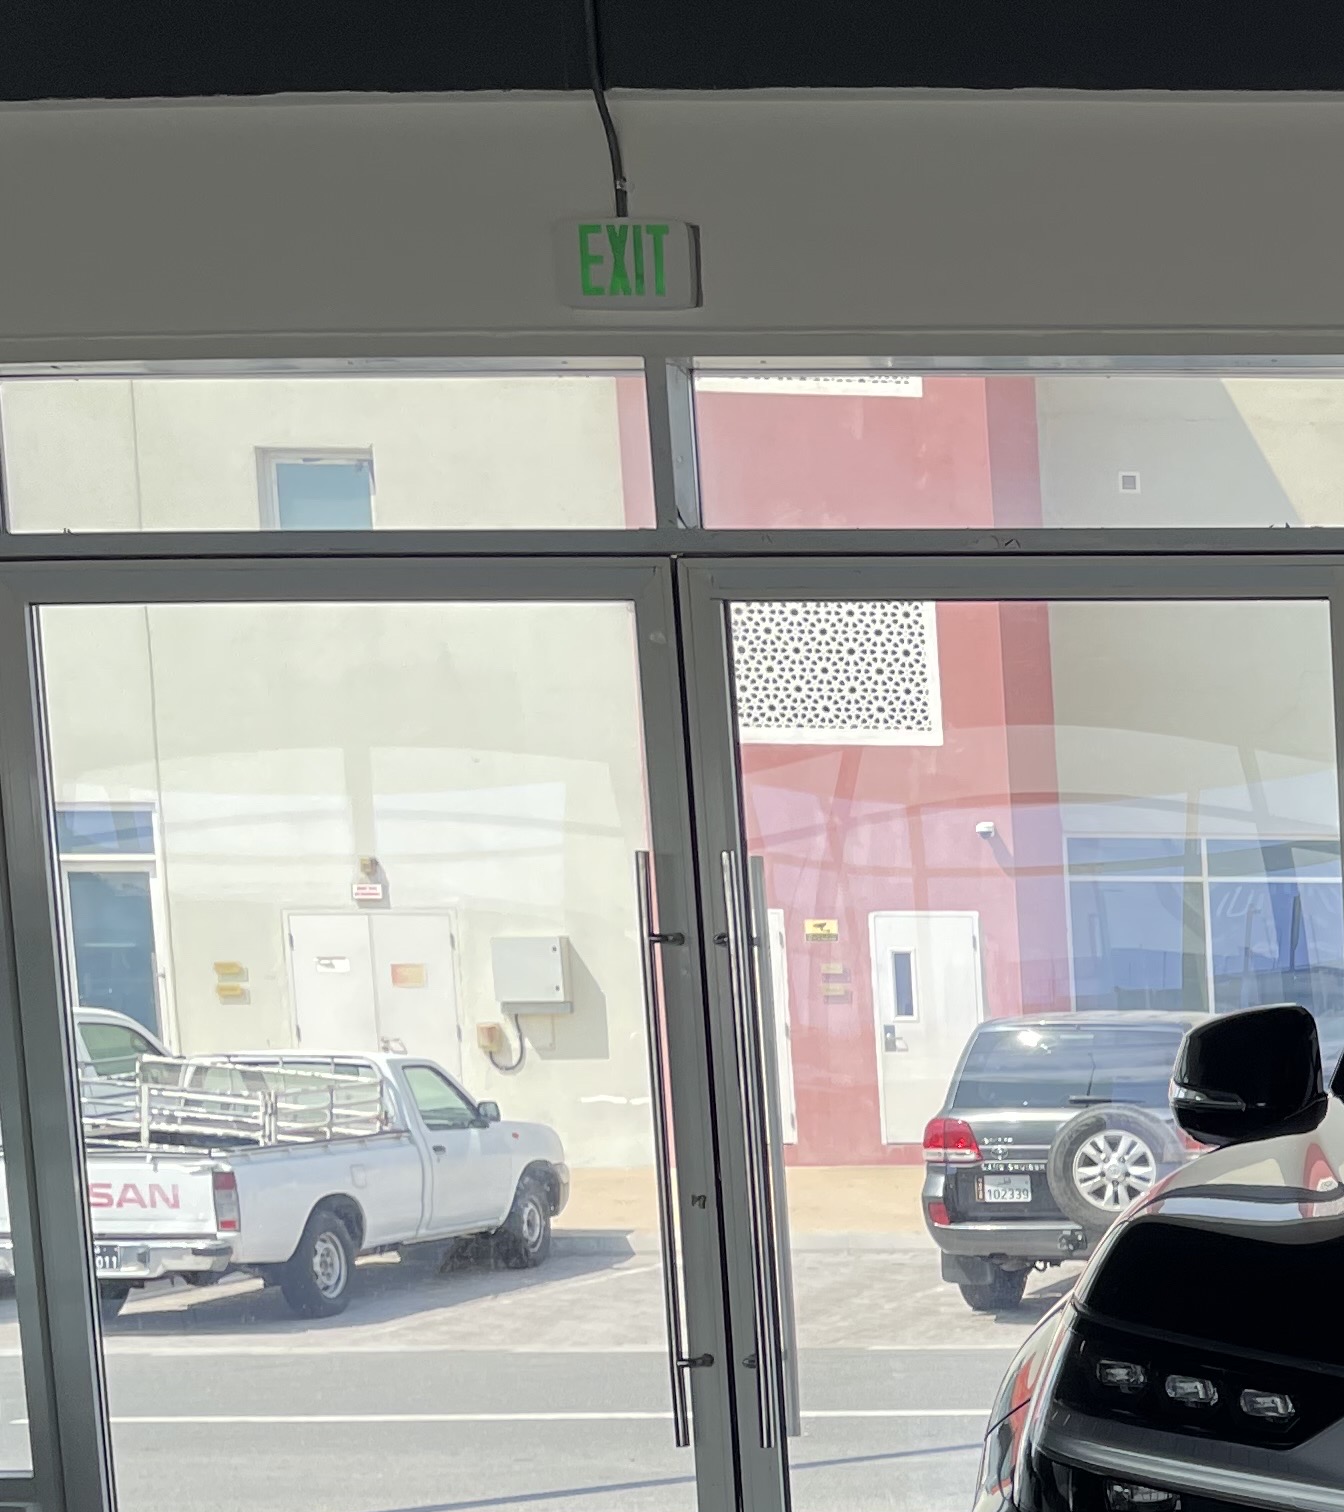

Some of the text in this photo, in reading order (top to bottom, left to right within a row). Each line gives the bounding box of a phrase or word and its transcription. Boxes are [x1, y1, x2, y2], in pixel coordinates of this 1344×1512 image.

[577, 223, 670, 297] EXIT
[89, 1182, 181, 1209] SAN
[987, 1188, 1030, 1201] 102339
[95, 1255, 118, 1269] 011
